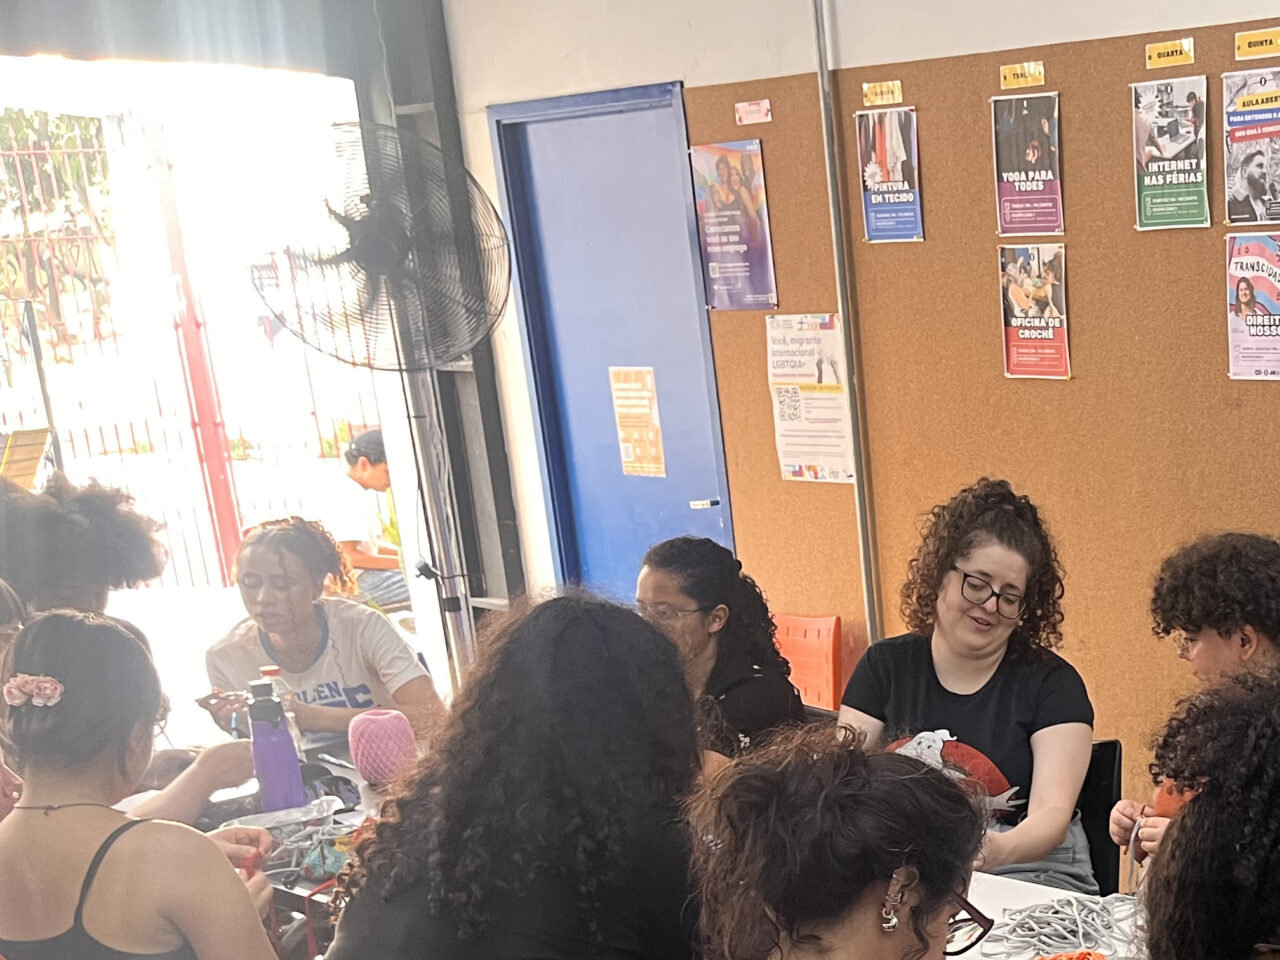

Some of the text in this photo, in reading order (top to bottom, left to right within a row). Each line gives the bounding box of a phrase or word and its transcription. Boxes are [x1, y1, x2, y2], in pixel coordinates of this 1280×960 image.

[1247, 38, 1274, 49] QUINTA
[1157, 49, 1184, 59] QUARTA
[1242, 98, 1260, 108] AULA
[1148, 158, 1198, 173] INTERNET
[1002, 169, 1054, 182] YOGA PARA
[1144, 170, 1204, 186] NAS FÉRIAS
[873, 181, 910, 192] PINTURA
[1014, 181, 1045, 191] TODES
[871, 192, 914, 204] EM TECIDO
[1011, 317, 1061, 327] OFICINA DE
[1018, 328, 1055, 339] CROCHÊ
